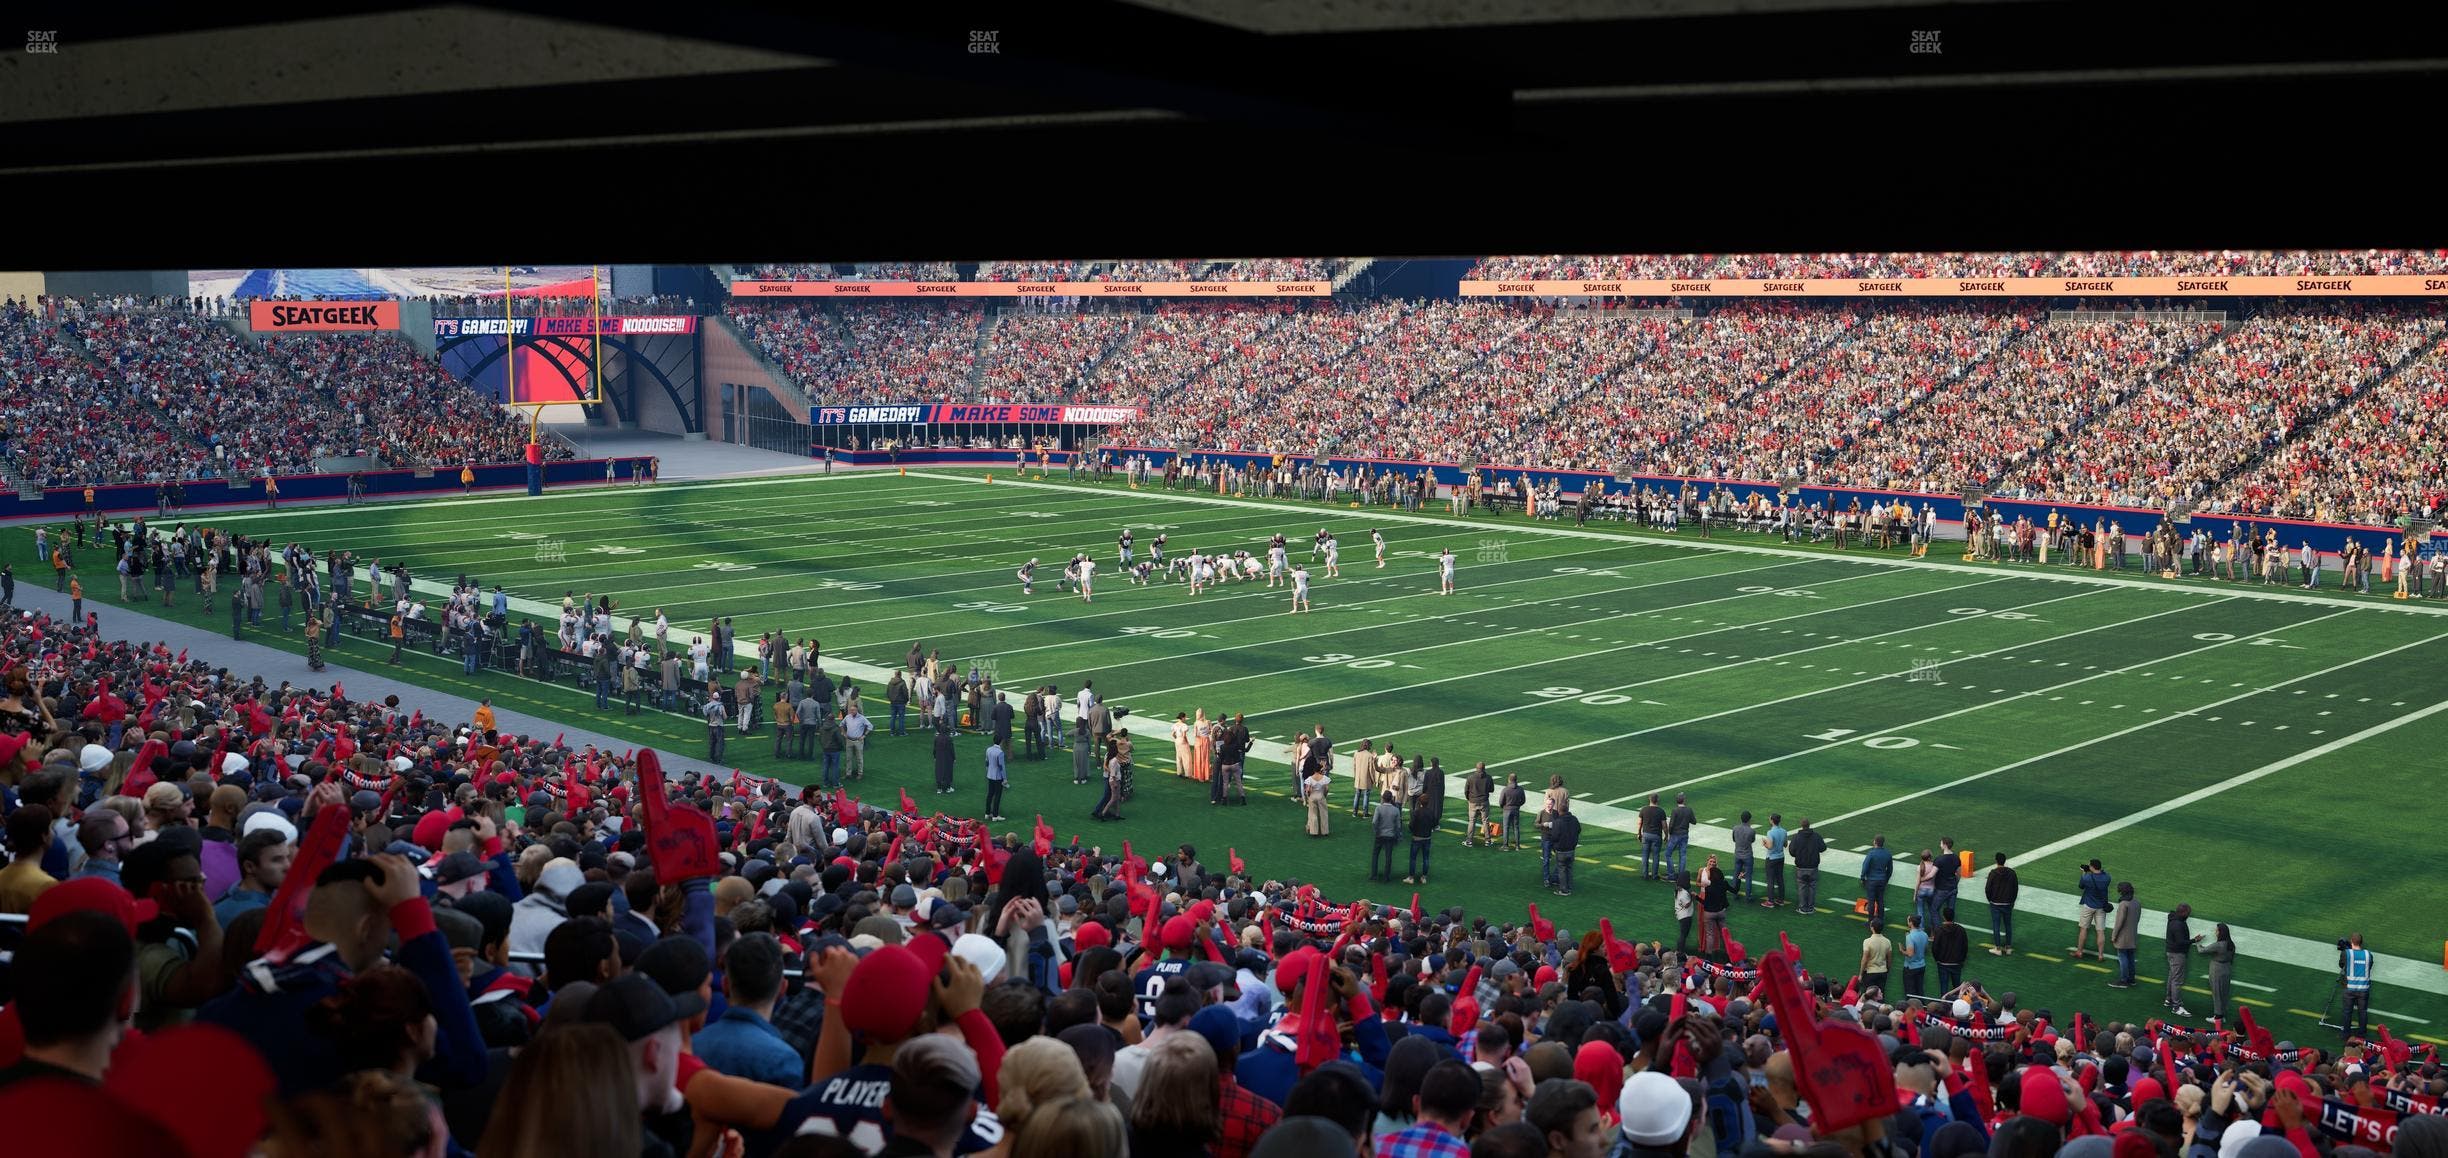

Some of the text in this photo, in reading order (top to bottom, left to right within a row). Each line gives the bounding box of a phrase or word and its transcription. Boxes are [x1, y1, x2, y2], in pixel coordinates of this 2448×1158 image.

[759, 285, 792, 293] SEATGEEK
[835, 285, 870, 293] SEATGEEK
[917, 285, 956, 293] SEATGEEK
[1017, 285, 1055, 293] SEATGEEK
[1104, 285, 1142, 293] SEATGEEK
[1190, 285, 1227, 293] SEATGEEK
[1277, 285, 1315, 293] SEATGEEK
[1498, 283, 1534, 292] SEATGEEK
[1583, 283, 1621, 292] SEATGEEK
[1671, 283, 1710, 292] SEATGEEK
[1763, 283, 1804, 292] SEATGEEK
[1859, 282, 1902, 291] SEATGEEK
[1960, 282, 2005, 291] SEATGEEK
[2065, 281, 2113, 291] SEATGEEK
[2177, 281, 2228, 291] SEATGEEK
[2297, 280, 2351, 290] SEATGEEK
[272, 305, 378, 326] SEATGEEK
[462, 319, 527, 334] GAMEDAY!
[546, 319, 582, 333] MAKE
[819, 408, 845, 424] IT'S
[849, 407, 920, 423] GAMEDAY!
[950, 406, 1011, 421] MAKE
[1019, 408, 1059, 422] SOME
[1280, 912, 1300, 927] LET'S
[1156, 963, 1182, 973] PLAYER
[1702, 962, 1719, 975] LET'S
[1951, 1026, 2004, 1039] GOOOOO!!!
[2163, 1024, 2180, 1036] LET'S
[2228, 1044, 2250, 1059] LET'S
[820, 1078, 891, 1108] PLAYER
[2386, 1091, 2427, 1114] LET'S
[2321, 1103, 2381, 1142] LET'S
